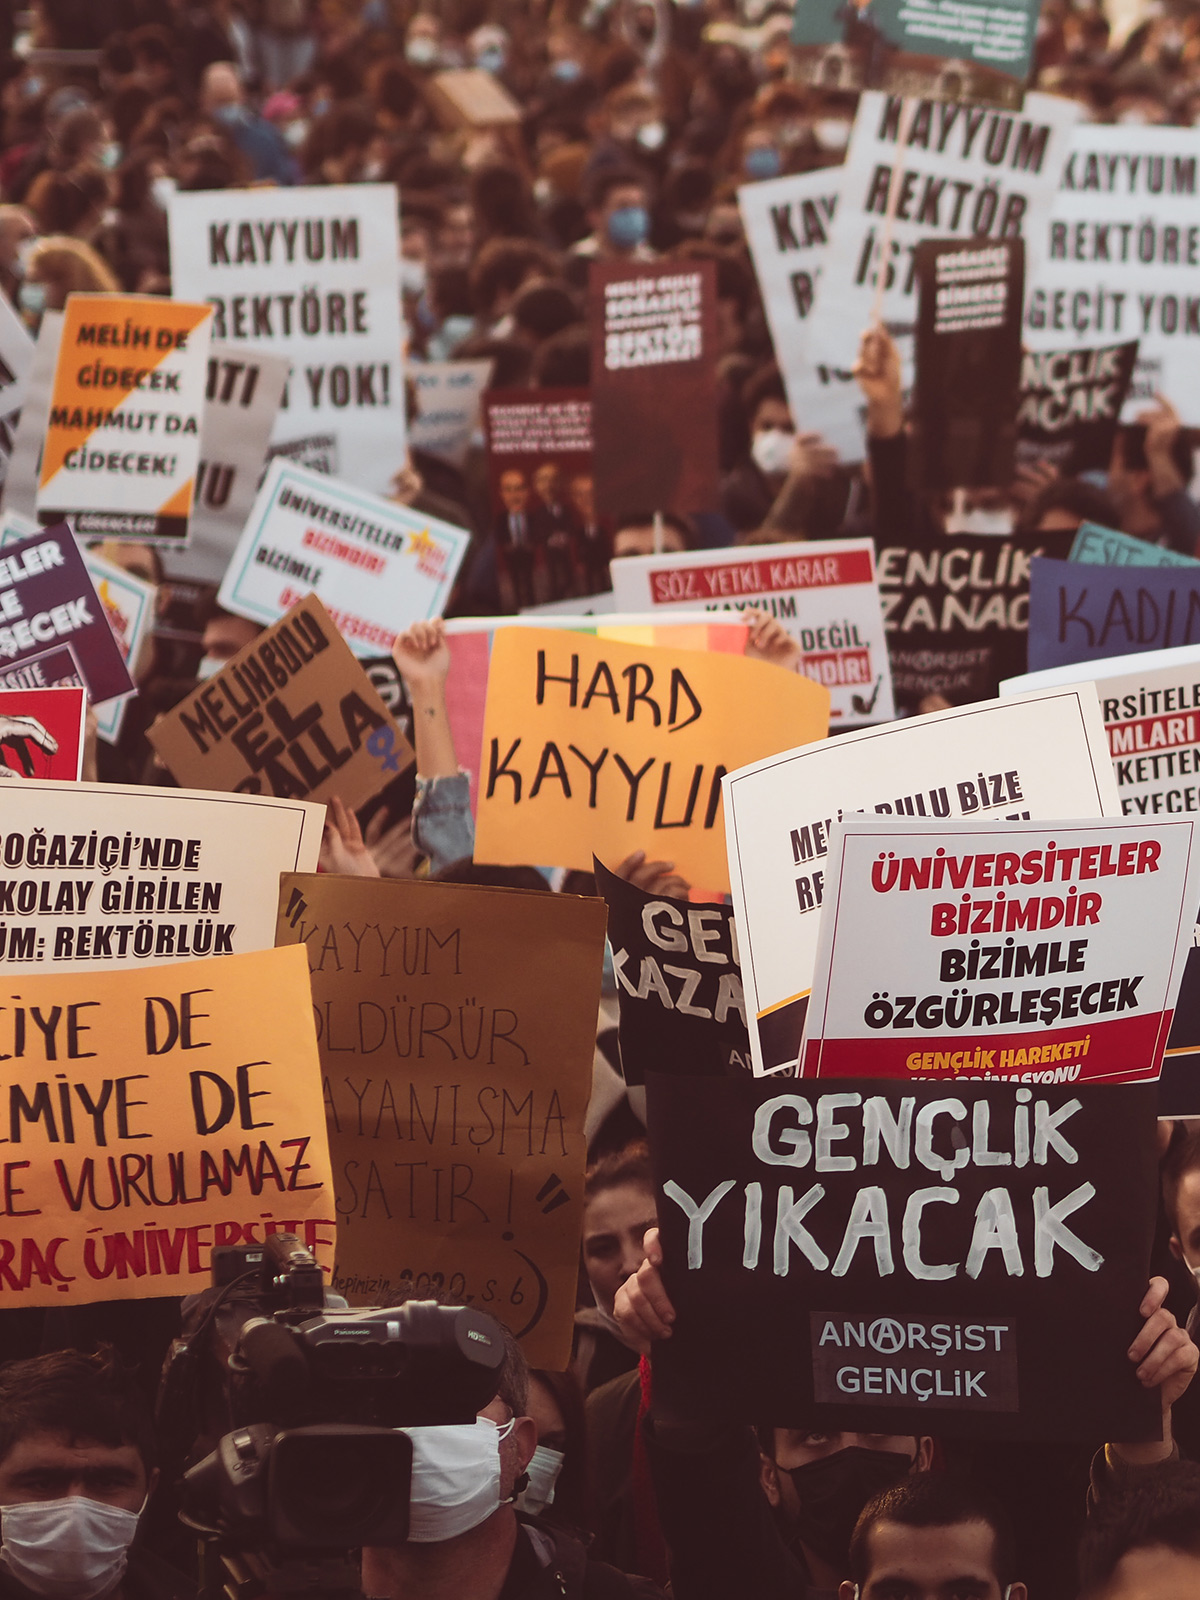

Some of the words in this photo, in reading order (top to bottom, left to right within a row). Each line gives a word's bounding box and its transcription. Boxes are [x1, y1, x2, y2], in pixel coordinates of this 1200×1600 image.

[209, 218, 359, 265] KAYYUM
[1050, 217, 1200, 266] REKTÖRE
[1027, 283, 1125, 338] GEÇİT
[77, 318, 151, 348] MELİH
[156, 330, 190, 351] DE
[77, 358, 181, 392] GİDECEK
[305, 363, 390, 409] YOK!
[49, 407, 159, 432] MAHMUT
[165, 415, 198, 435] DA
[63, 443, 177, 476] GİDECEK!
[279, 487, 404, 551] ÜNİVERSİTELER
[256, 546, 322, 586] BİZİMLE
[770, 557, 839, 588] KARAR
[801, 620, 871, 651] DEĞİL,
[536, 650, 702, 733] HARD
[230, 696, 323, 774] EL
[957, 770, 1024, 815] BİZE
[0, 827, 201, 875] OĞAZİÇİ'NDE
[870, 839, 1162, 893] ÜNİVERSİTELER
[0, 880, 94, 914] KOLAY
[100, 876, 222, 913] GİRİLEN
[930, 885, 1103, 937] BİZİMDİR
[53, 919, 236, 959] REKTÖRLÜK
[939, 937, 1089, 983] BİZİMLE
[0, 995, 101, 1061] İYE
[144, 988, 213, 1055] DE
[864, 975, 1144, 1029] ÖZGÜRLEŞECEK
[905, 1045, 997, 1075] GENÇLİK
[999, 1034, 1091, 1068] HAREKETİ
[0, 1074, 152, 1146] MİYE
[189, 1061, 274, 1135] DE
[752, 1087, 1083, 1181] GENÇLİK
[54, 1136, 324, 1212] VURULAMAZ
[663, 1179, 1105, 1280] YIKACAK
[334, 1328, 371, 1336] Panasonic
